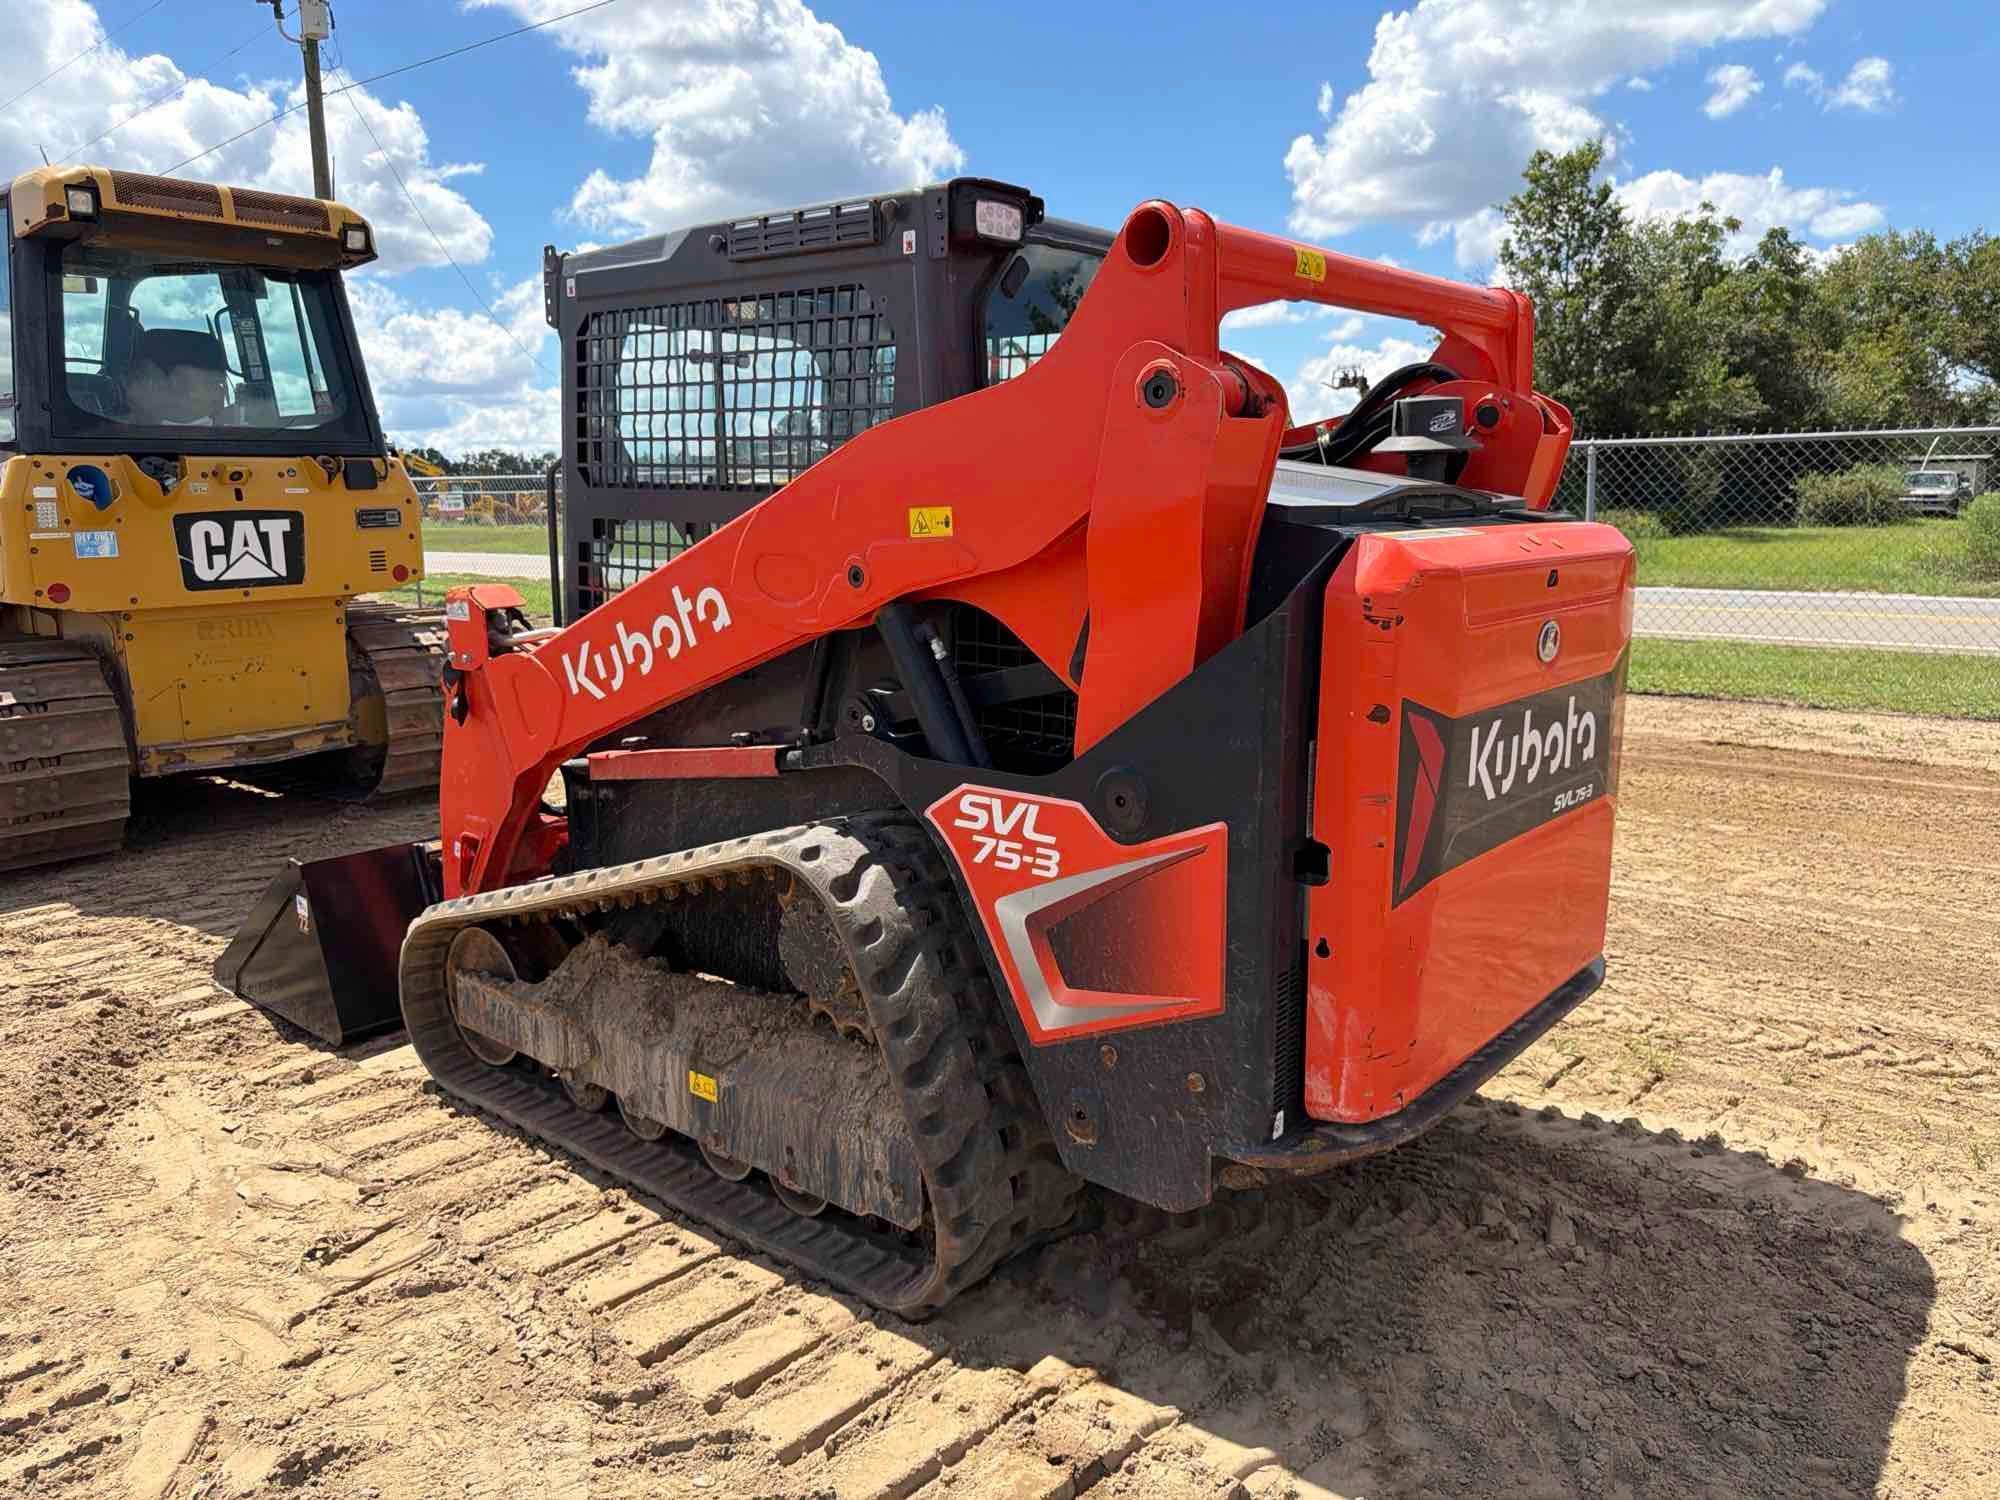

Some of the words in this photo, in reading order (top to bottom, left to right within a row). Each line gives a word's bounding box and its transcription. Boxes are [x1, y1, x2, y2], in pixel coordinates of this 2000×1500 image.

[190, 519, 291, 582] CAT
[561, 585, 732, 700] Kubota
[1468, 695, 1596, 801] Kubota
[954, 794, 1057, 845] SVL
[972, 834, 1061, 879] 75-3
